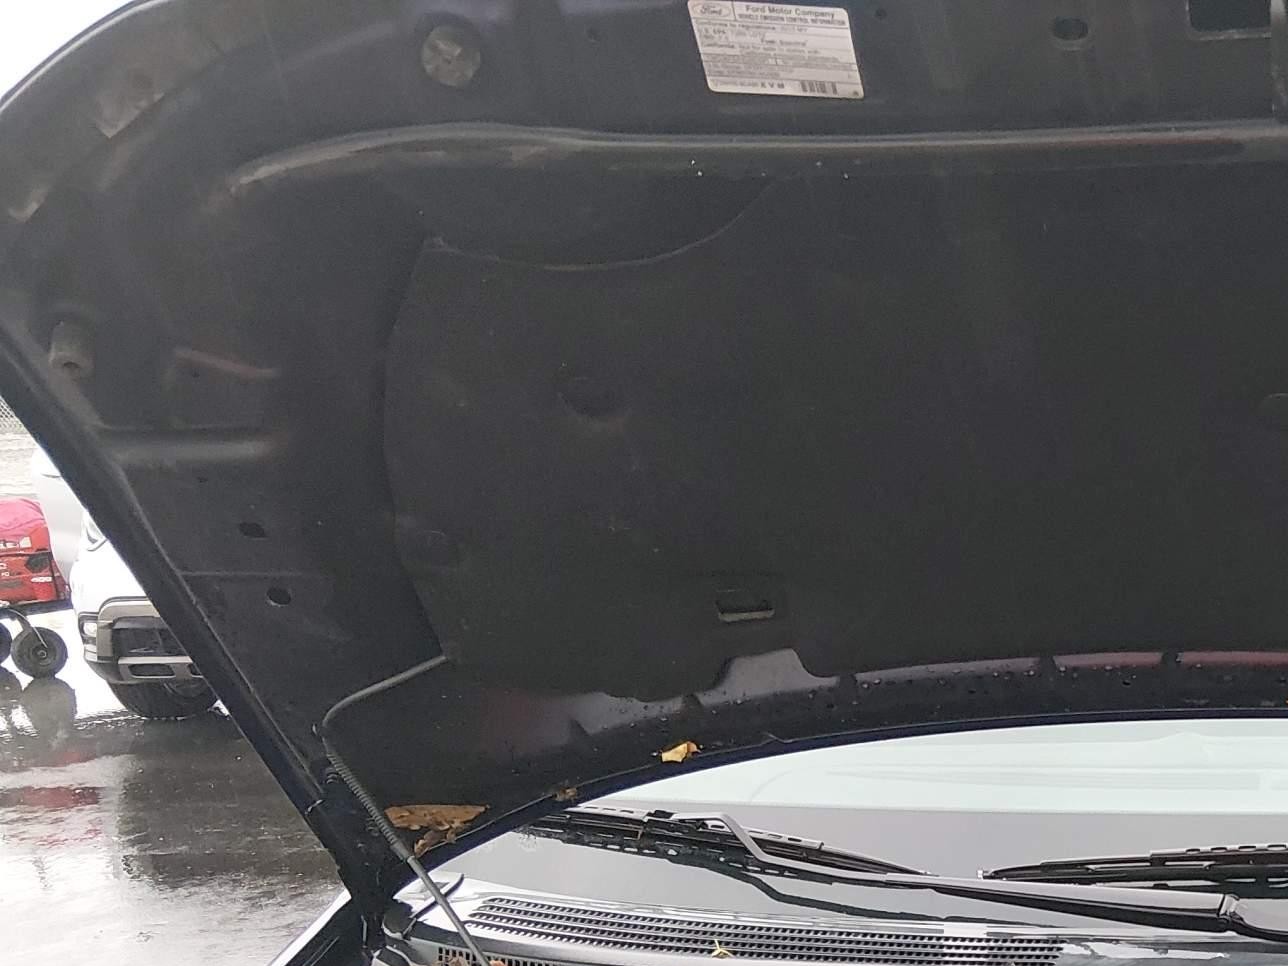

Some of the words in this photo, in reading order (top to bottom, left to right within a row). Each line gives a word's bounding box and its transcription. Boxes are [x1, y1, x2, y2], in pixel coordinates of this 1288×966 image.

[746, 5, 765, 13] Ford
[768, 6, 792, 15] Motor
[795, 8, 834, 19] Company
